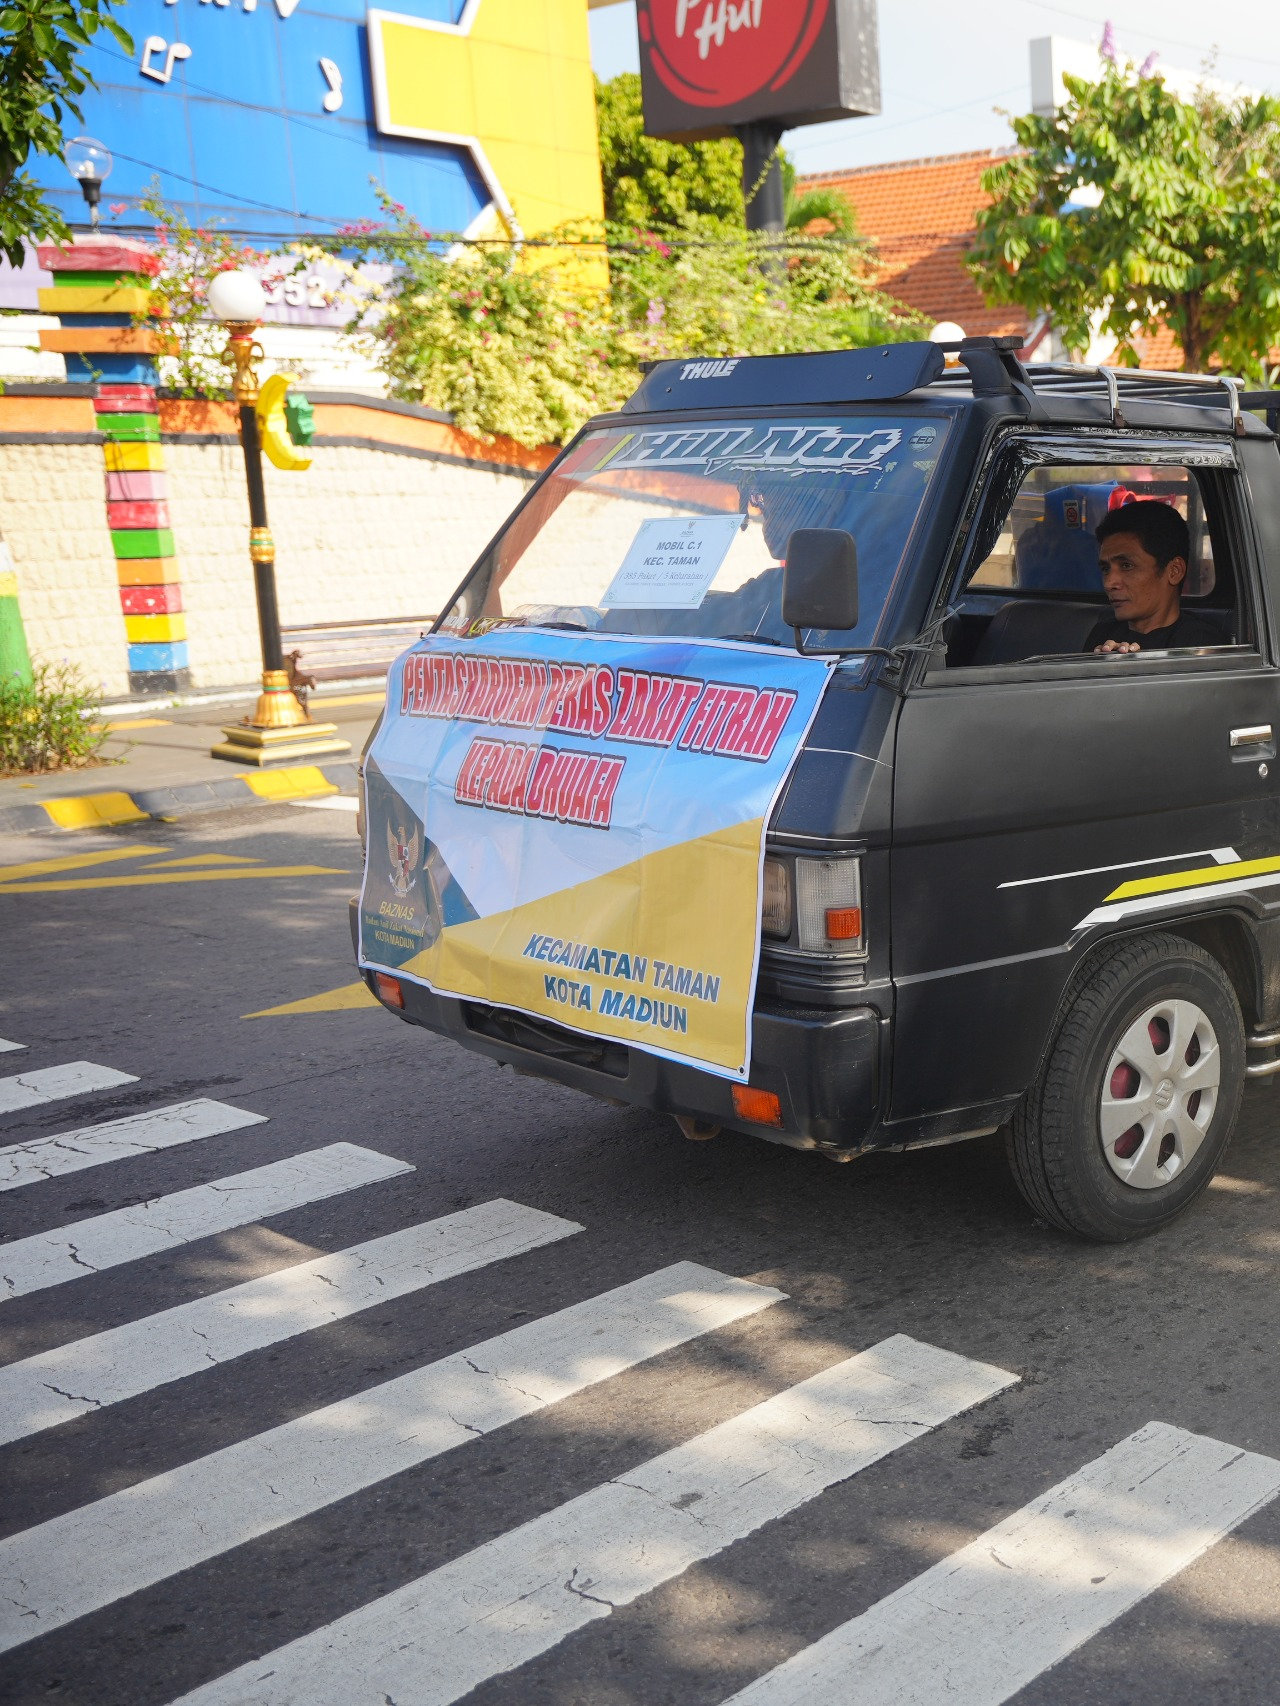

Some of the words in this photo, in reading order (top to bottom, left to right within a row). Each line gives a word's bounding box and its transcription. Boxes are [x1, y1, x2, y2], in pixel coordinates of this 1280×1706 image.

[679, 360, 739, 381] THULE
[643, 557, 664, 566] KEC.
[668, 557, 701, 566] TAMAN
[656, 541, 684, 551] MOBIL
[687, 541, 702, 550] C.1
[402, 653, 548, 730] PENTASHARUFAN
[536, 661, 616, 738] BERAS
[606, 668, 704, 748] ZAKAT
[678, 681, 798, 763] FITRAH
[455, 737, 540, 813] KEPADA
[525, 746, 627, 829] DHUAFA
[379, 901, 415, 921] BAZNAS
[522, 932, 649, 984] KECAMATAN
[652, 959, 721, 1004] TAMAN
[543, 974, 593, 1011] KOTA
[598, 988, 688, 1034] MADIUN
